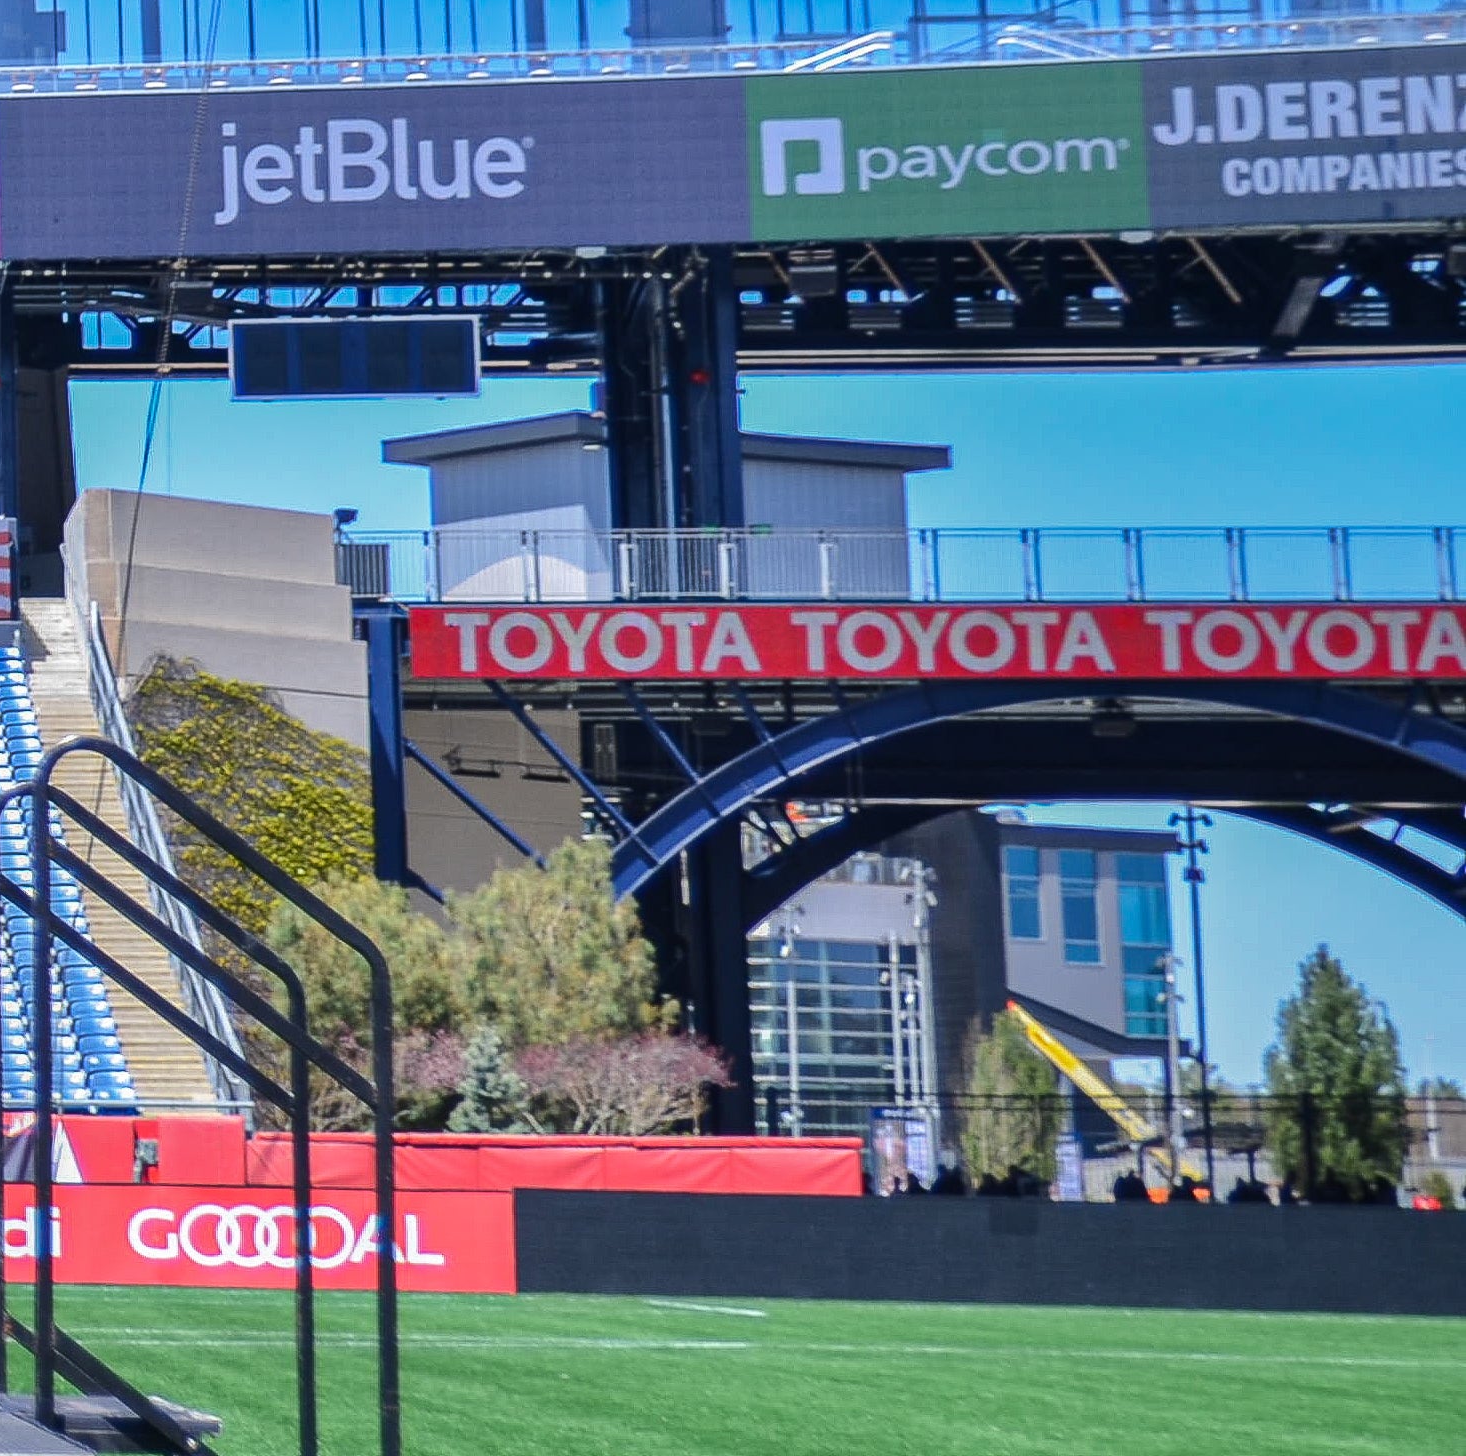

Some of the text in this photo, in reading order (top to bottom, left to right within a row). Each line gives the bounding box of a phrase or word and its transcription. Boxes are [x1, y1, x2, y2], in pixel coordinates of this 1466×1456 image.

[214, 117, 528, 226] jetBlue
[857, 136, 1118, 192] paycom
[441, 609, 1466, 672] TOYOTA TOYOTA TOYOTA
